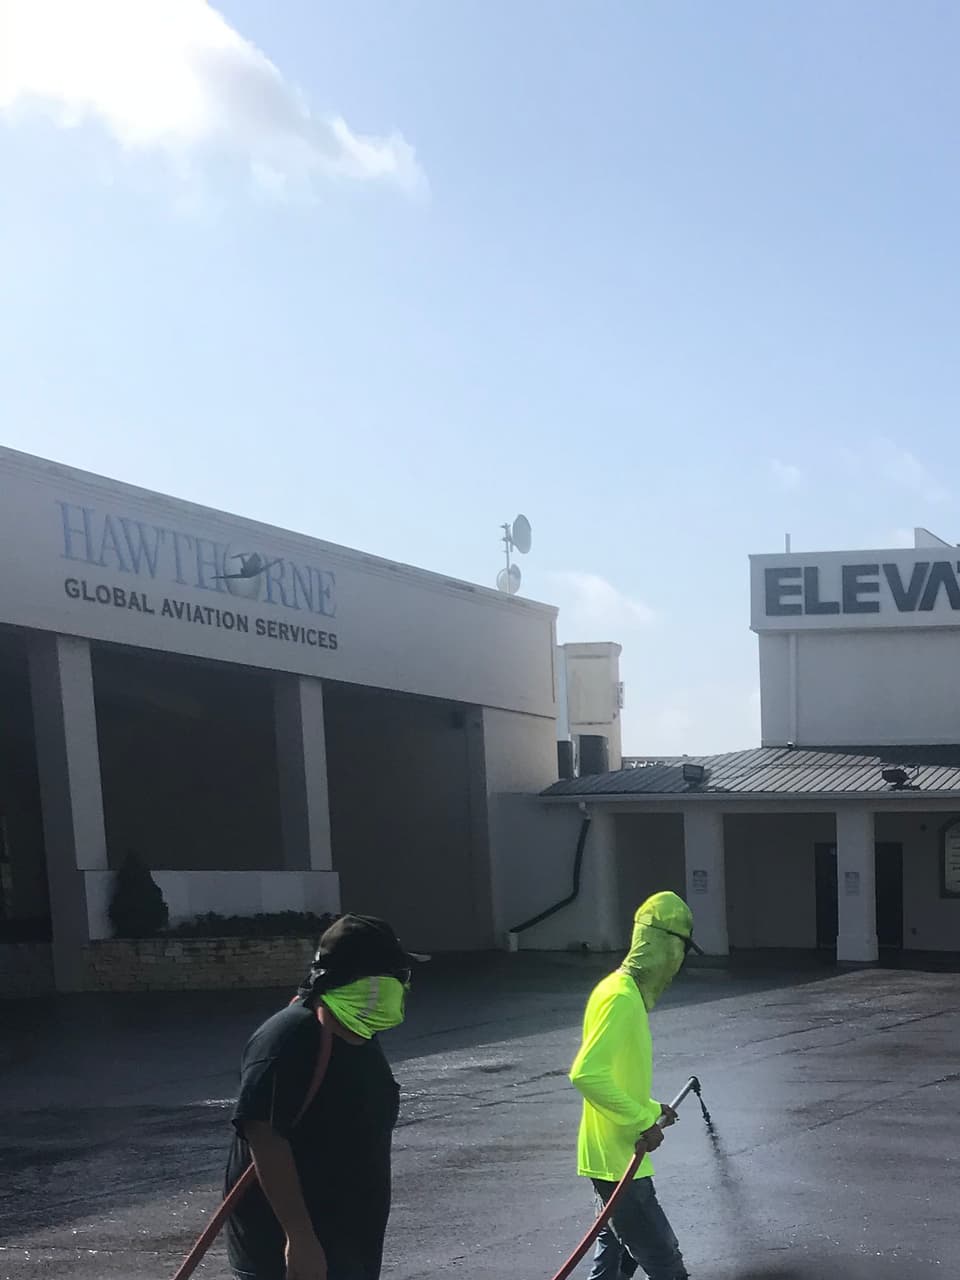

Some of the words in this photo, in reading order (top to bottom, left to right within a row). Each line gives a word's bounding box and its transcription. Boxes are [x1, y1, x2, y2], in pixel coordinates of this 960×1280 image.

[57, 501, 337, 618] HAWTHORNE
[64, 578, 154, 614] GLOBAL
[161, 598, 249, 633] AVIATION
[255, 618, 338, 650] SERVICES
